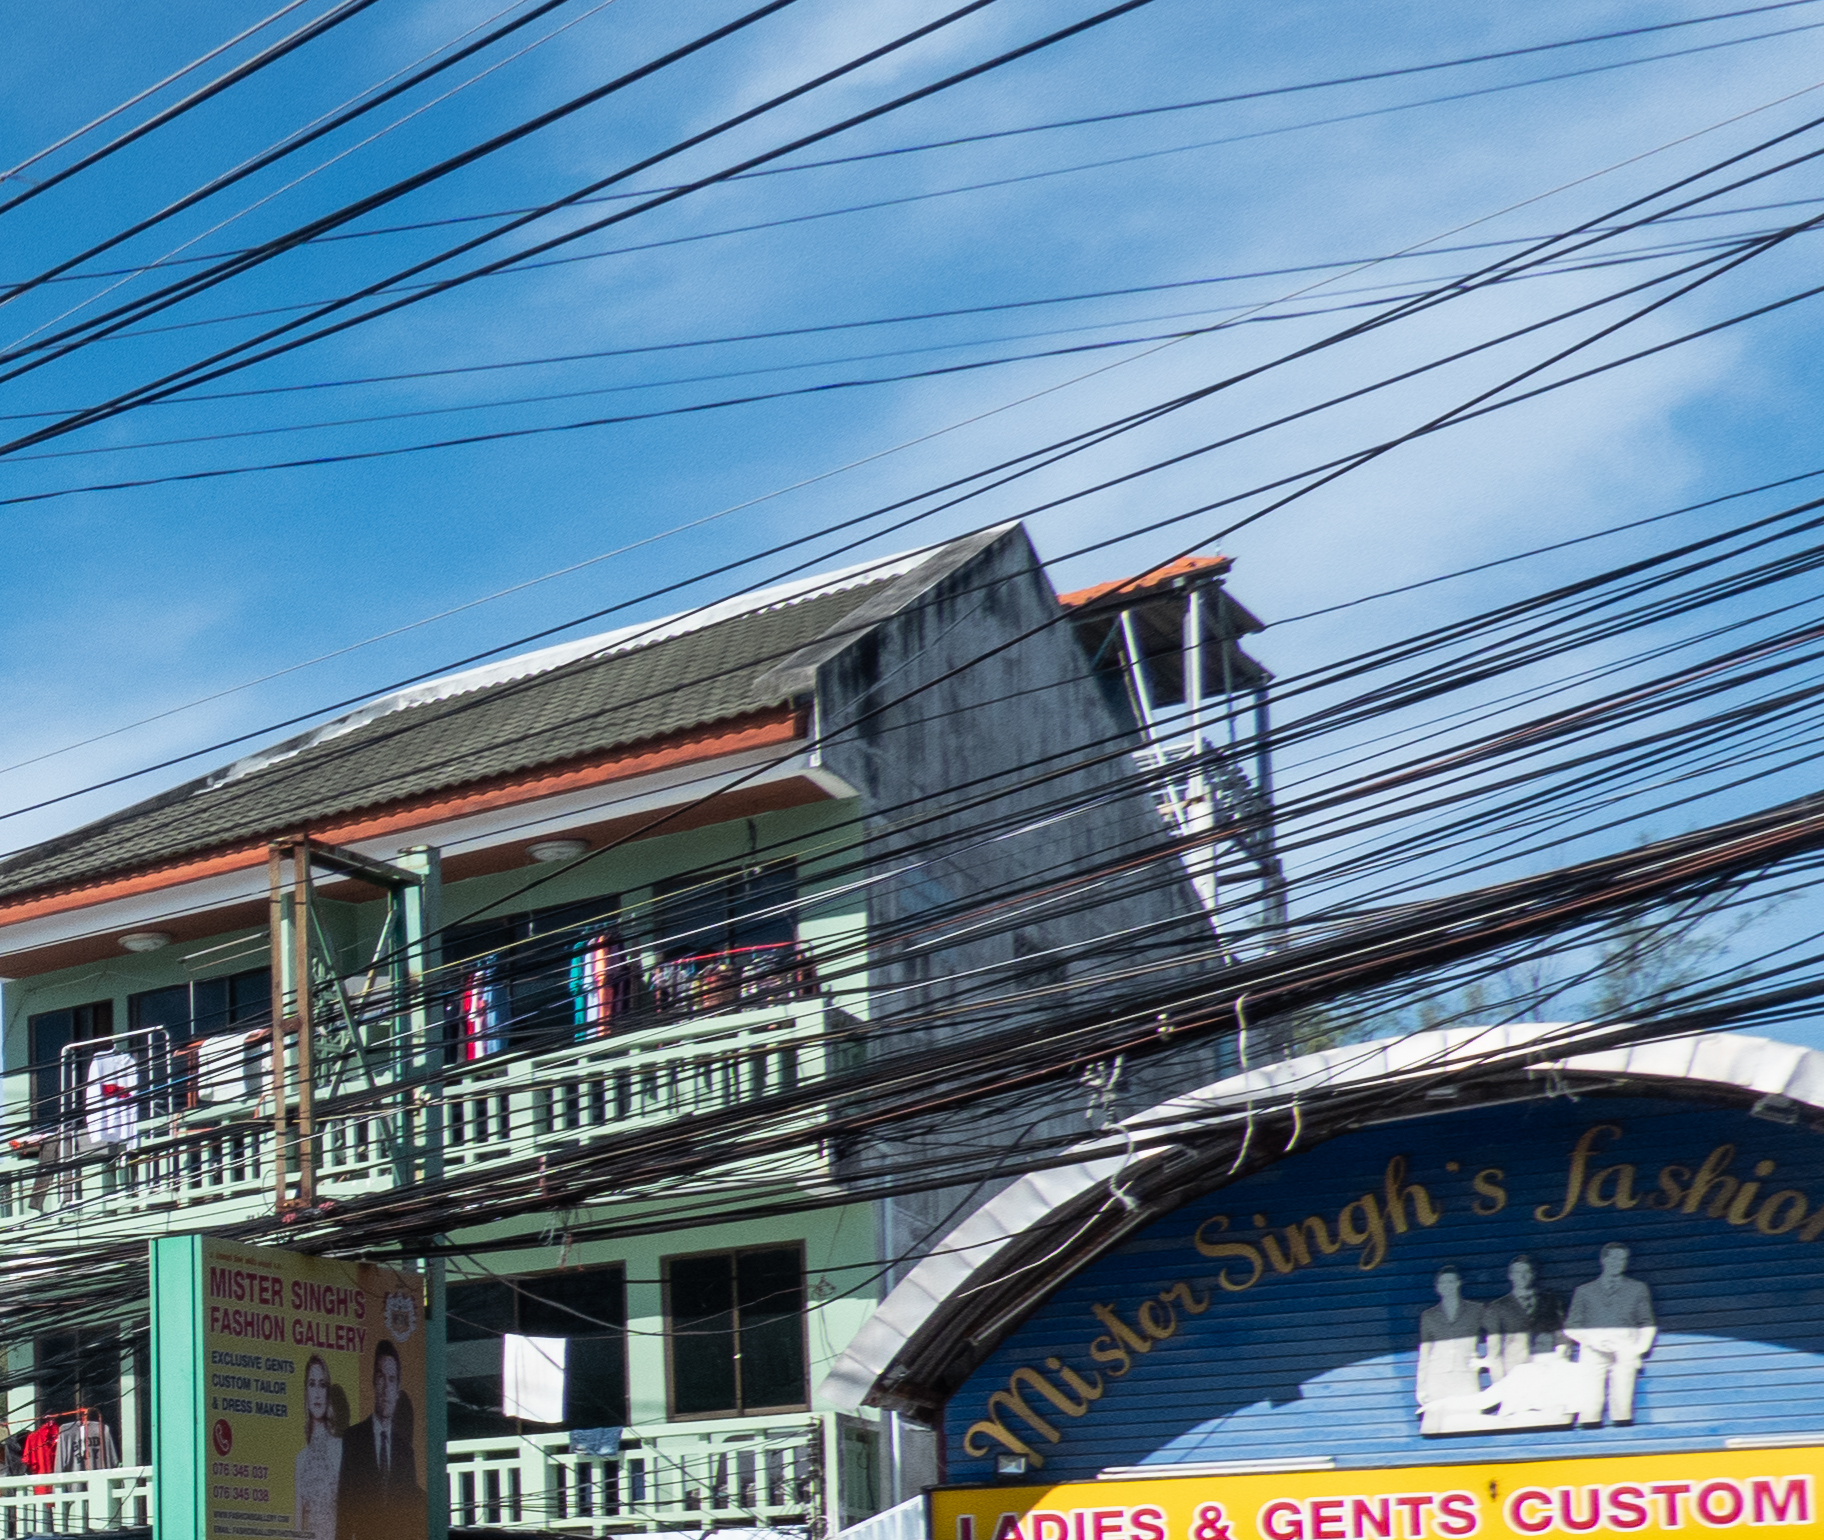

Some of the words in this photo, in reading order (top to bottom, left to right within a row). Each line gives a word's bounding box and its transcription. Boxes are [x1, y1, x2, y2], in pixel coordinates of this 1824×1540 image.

[210, 1266, 284, 1307] MISTER
[291, 1280, 366, 1319] SINGH'S
[963, 1281, 1210, 1469] Mister
[1194, 1155, 1508, 1291] Singh's
[210, 1306, 285, 1342] FASHION
[292, 1319, 367, 1353] GALLERY
[211, 1350, 263, 1370] EXCLUSIVE
[265, 1358, 295, 1374] GENTS
[212, 1373, 252, 1391] CUSTOM
[254, 1379, 287, 1395] TAILOR
[212, 1397, 219, 1409] &
[222, 1398, 252, 1413] DRESS
[255, 1401, 288, 1417] MAKER
[1503, 1475, 1814, 1536] CUSTOM
